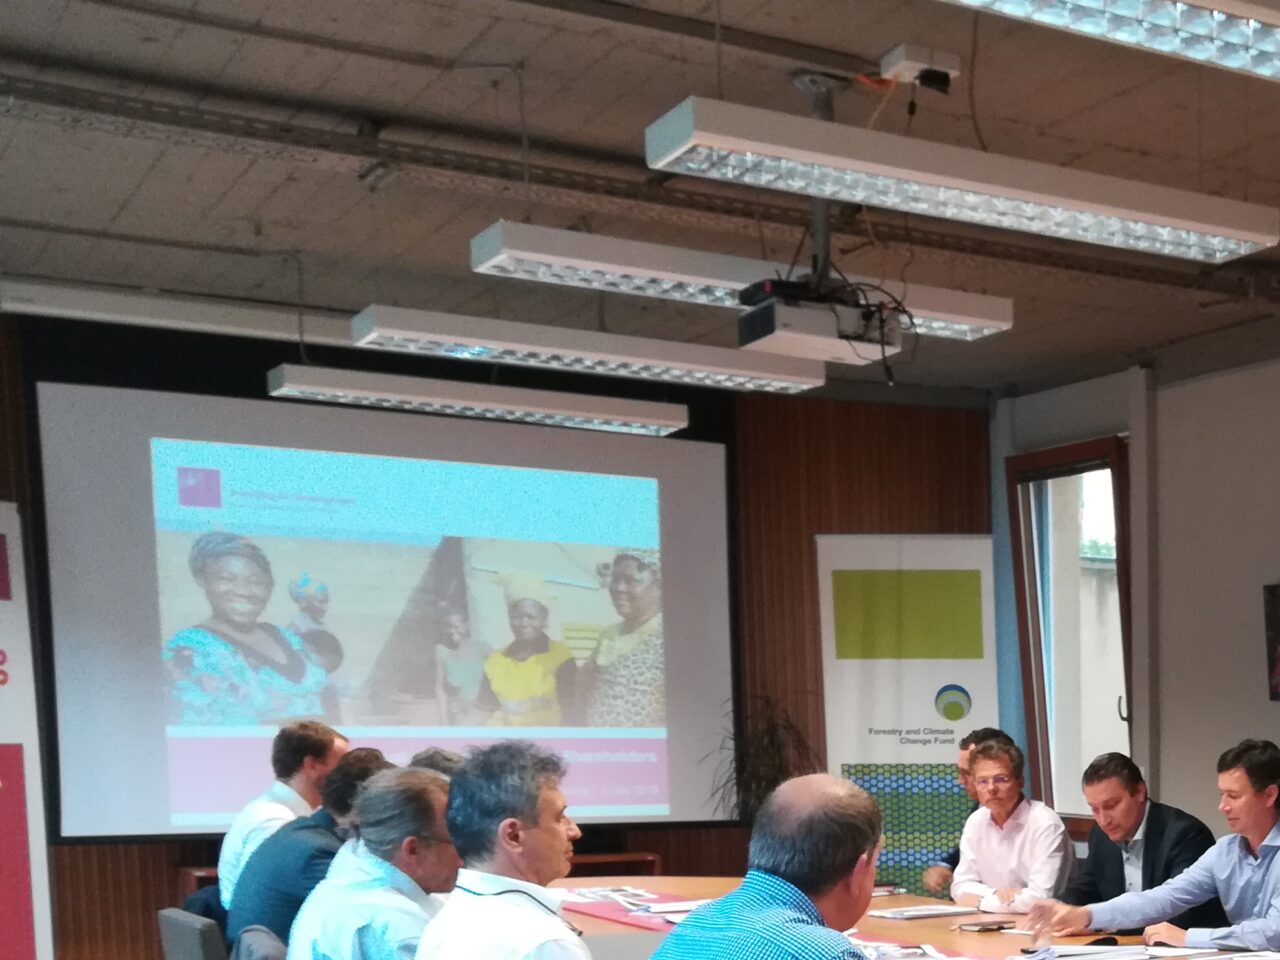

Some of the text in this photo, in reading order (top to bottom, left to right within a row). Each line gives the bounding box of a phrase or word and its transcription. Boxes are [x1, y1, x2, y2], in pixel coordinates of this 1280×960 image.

[868, 727, 955, 737] Forestry and Climate
[899, 737, 955, 746] Change Fund
